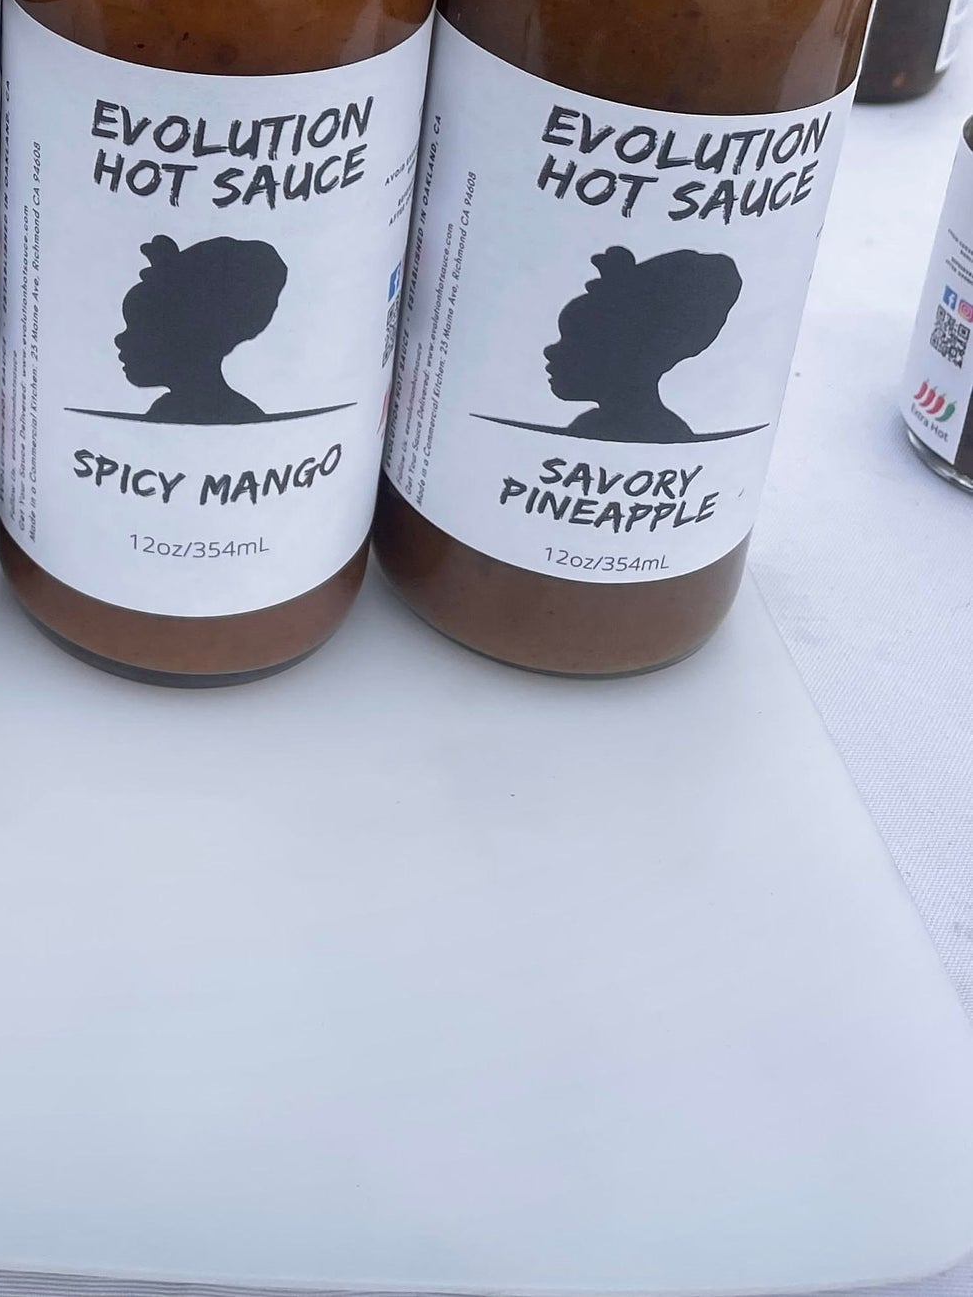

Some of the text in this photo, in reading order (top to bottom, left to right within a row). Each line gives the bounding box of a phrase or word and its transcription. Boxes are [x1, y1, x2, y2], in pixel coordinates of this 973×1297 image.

[91, 95, 374, 162] EVOLUTION
[541, 104, 832, 174] EVOLUTION
[93, 149, 199, 208] HOT
[211, 143, 368, 211] SAUCE
[419, 209, 427, 225] IN
[433, 115, 441, 134] CA
[463, 171, 477, 206] 94608
[536, 153, 820, 225] HOT SAUCE
[33, 188, 40, 206] CA
[460, 209, 471, 226] CA
[32, 208, 40, 271] Richmond
[452, 227, 467, 280] Richmond
[448, 284, 459, 306] Ave,
[31, 304, 39, 343] Maine
[443, 308, 454, 340] Maine
[29, 412, 38, 483] Commercial
[423, 397, 439, 457] Commercial
[73, 443, 343, 506] SPICY MANGO
[405, 476, 413, 495] Get
[411, 421, 422, 451] Sauce
[421, 468, 428, 478] in
[538, 457, 704, 500] SAVORY
[416, 479, 426, 507] Made
[499, 476, 720, 534] PINEAPPLE
[129, 534, 270, 559] 12oz/354mL
[544, 546, 670, 572] 12oz/354mL
